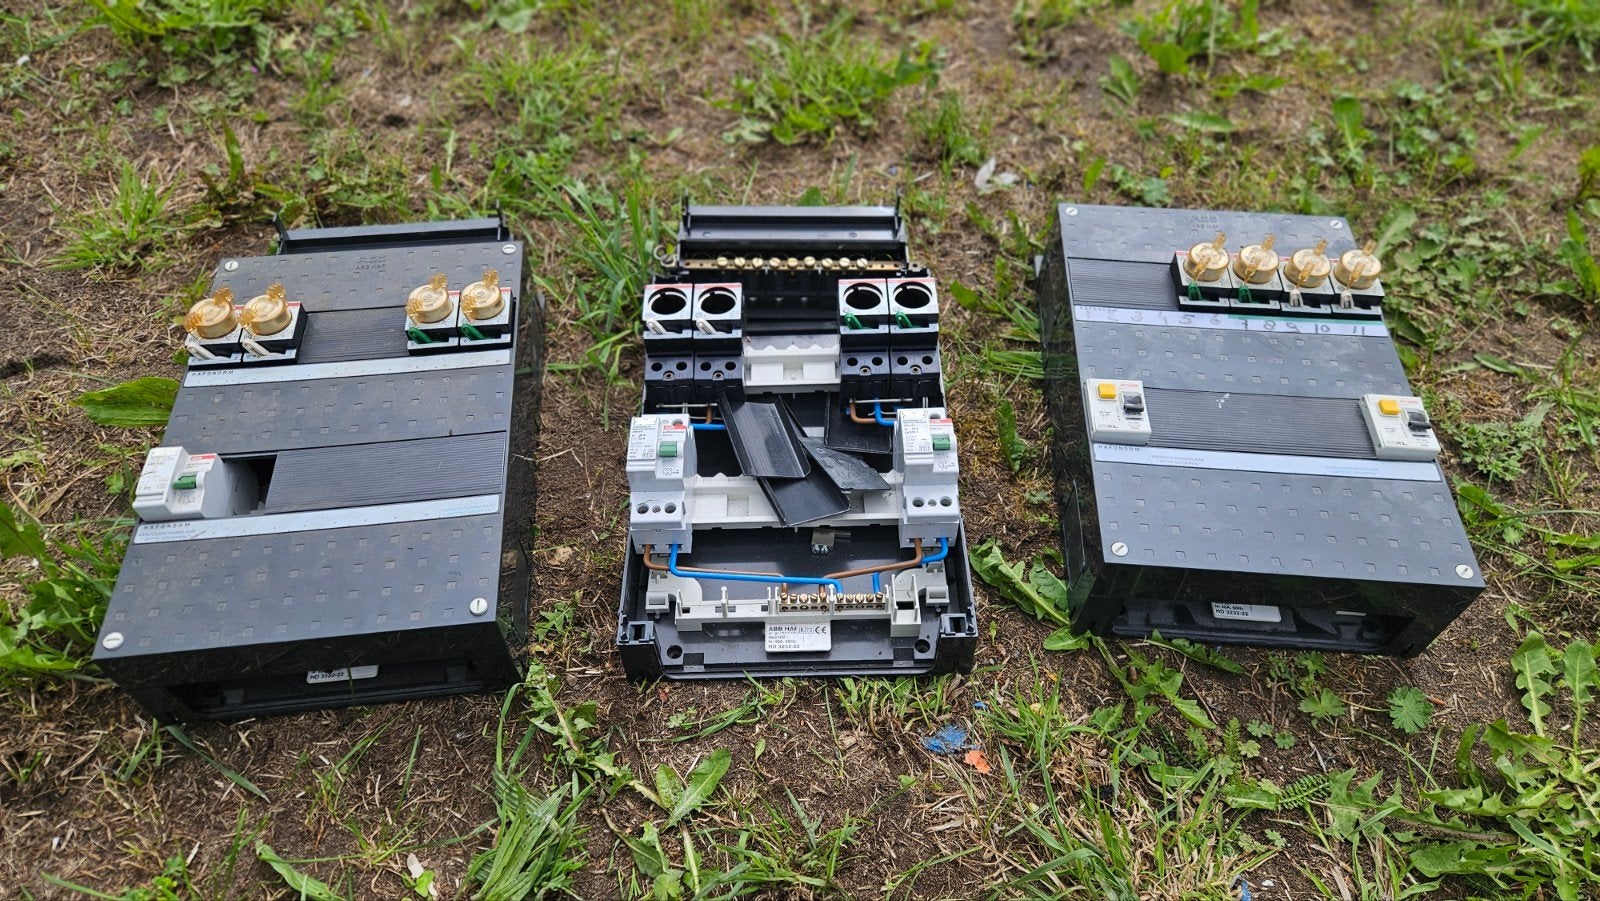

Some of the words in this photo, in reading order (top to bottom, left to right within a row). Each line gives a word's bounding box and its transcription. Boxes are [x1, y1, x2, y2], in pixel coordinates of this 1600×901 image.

[1131, 310, 1143, 322] 3
[1179, 314, 1195, 324] 5
[1264, 320, 1276, 331] 8
[1315, 324, 1331, 334] 10
